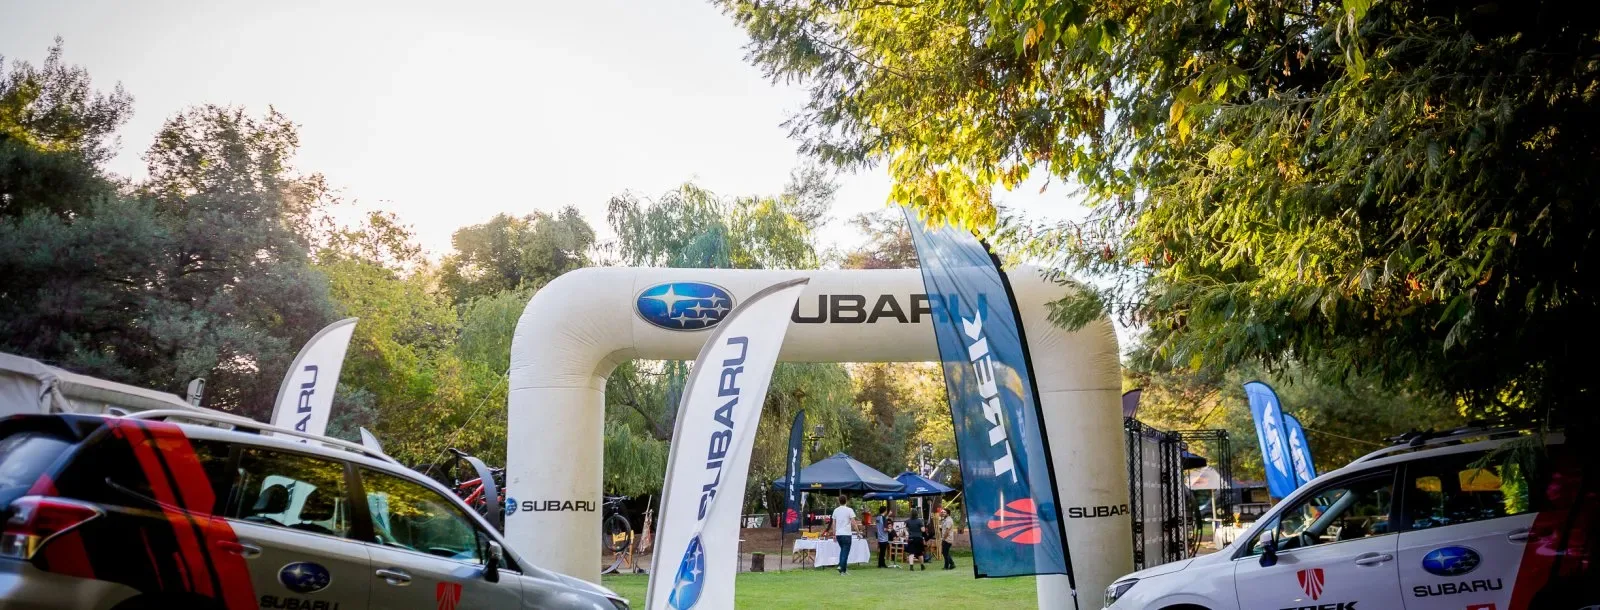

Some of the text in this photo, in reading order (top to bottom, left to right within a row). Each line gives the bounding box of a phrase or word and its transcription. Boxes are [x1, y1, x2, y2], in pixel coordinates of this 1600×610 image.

[791, 293, 987, 325] UBARU
[295, 365, 318, 433] ARU
[698, 336, 749, 522] SUBARU
[521, 499, 596, 512] SUBARU
[1068, 504, 1130, 519] SUBAR
[1412, 578, 1503, 597] SUBARU
